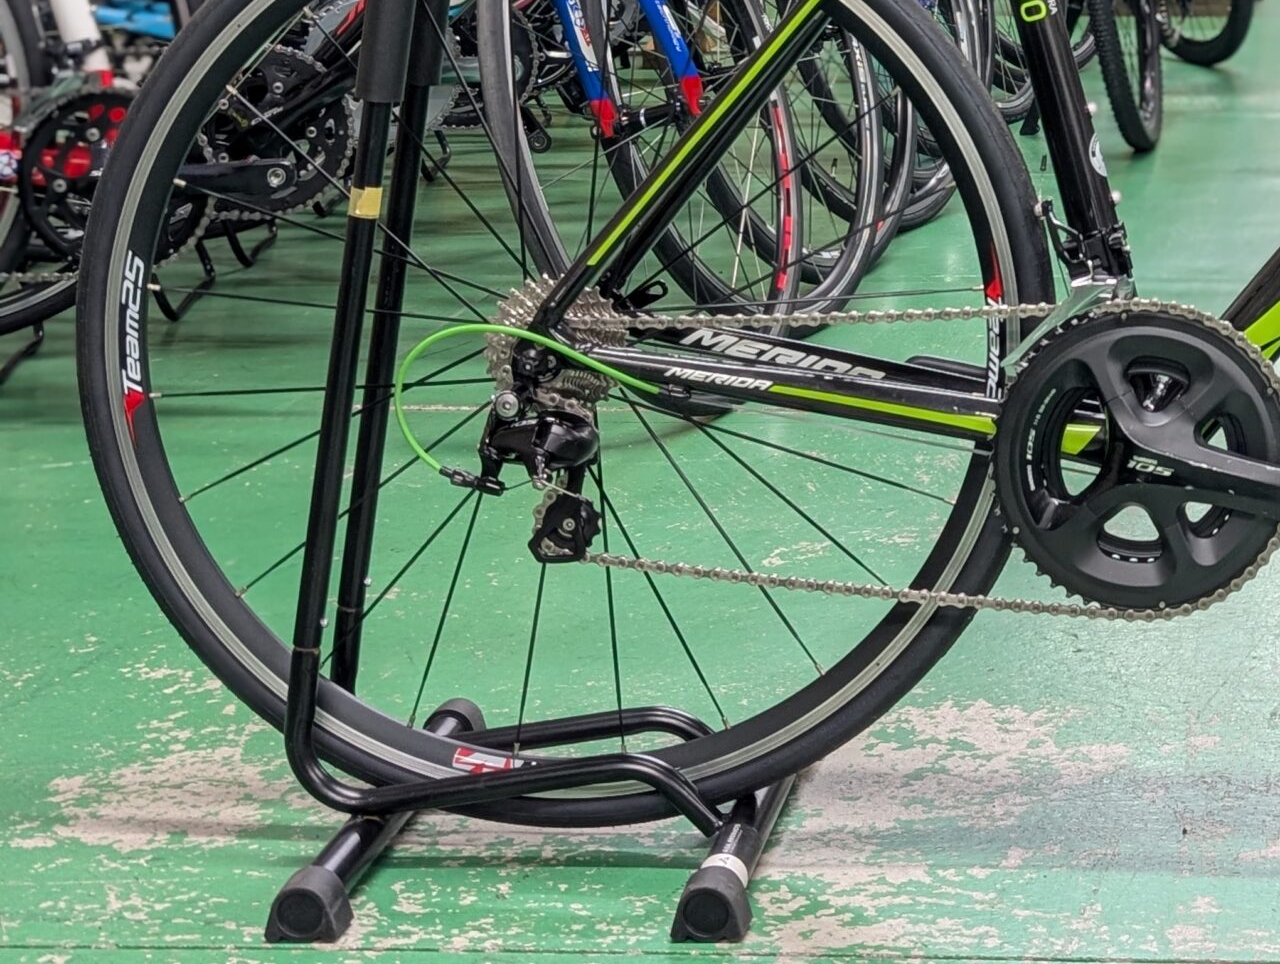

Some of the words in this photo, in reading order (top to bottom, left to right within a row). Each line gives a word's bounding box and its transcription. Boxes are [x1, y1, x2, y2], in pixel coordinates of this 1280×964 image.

[121, 249, 145, 395] Team25
[664, 367, 774, 390] MERIDA
[1127, 460, 1175, 476] 105
